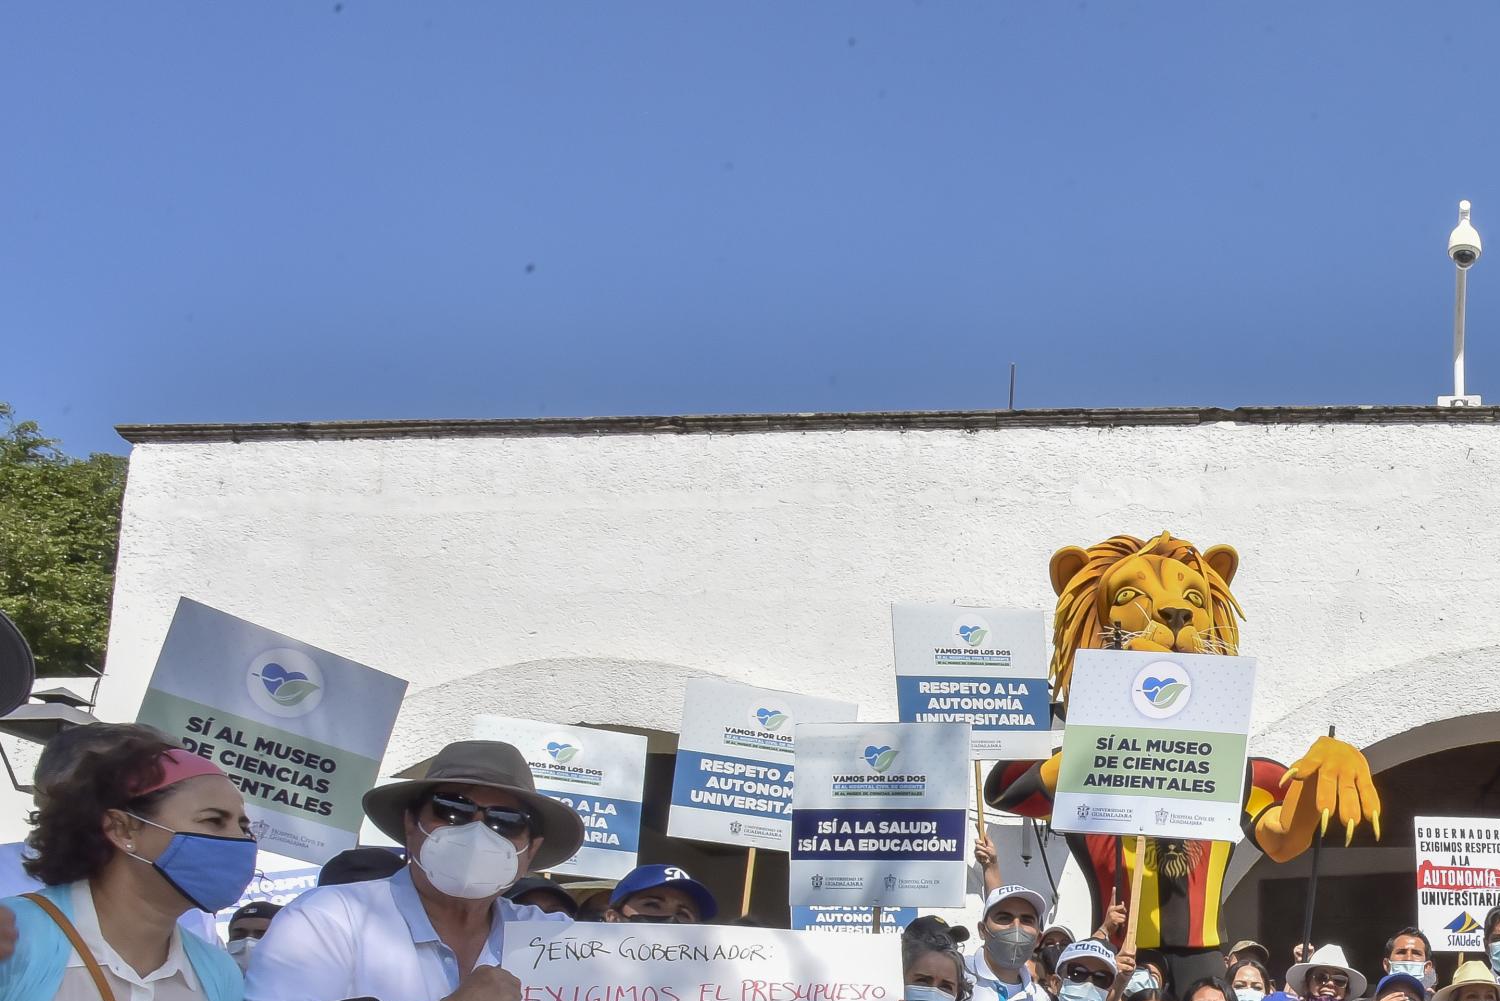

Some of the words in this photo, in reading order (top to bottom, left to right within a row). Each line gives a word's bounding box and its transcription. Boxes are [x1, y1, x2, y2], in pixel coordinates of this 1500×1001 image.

[919, 682, 990, 694] RESPETO
[994, 684, 1006, 694] A
[1009, 684, 1028, 695] LA
[928, 696, 1023, 710] AUTONOMÍA
[916, 713, 1035, 725] UNIVERSITARIA
[186, 717, 215, 734] SÍ
[215, 727, 248, 747] AL
[254, 737, 336, 773] MUSEO
[1097, 734, 1115, 750] SÍ
[1119, 738, 1141, 752] AL
[1147, 739, 1212, 756] MUSEO
[183, 737, 214, 758] DE
[220, 751, 329, 793] CIENCIAS
[1094, 755, 1119, 769] DE
[1122, 756, 1210, 774] CIENCIAS
[1083, 773, 1216, 793] AMBIENTALES
[230, 773, 333, 816] ENTALES
[840, 822, 852, 833] A
[855, 822, 877, 833] LA
[879, 821, 936, 834] SALUD!
[820, 840, 833, 851] A
[835, 840, 856, 851] LA
[859, 836, 956, 851] EDUCACIÓN!
[1420, 842, 1462, 853] EXIGIMOS
[1451, 856, 1458, 866] A
[1460, 856, 1470, 866] LA
[1423, 866, 1497, 887] AUTONOMÍA
[529, 937, 612, 969] SEÑOR
[619, 937, 774, 962] GOBERNADOR:
